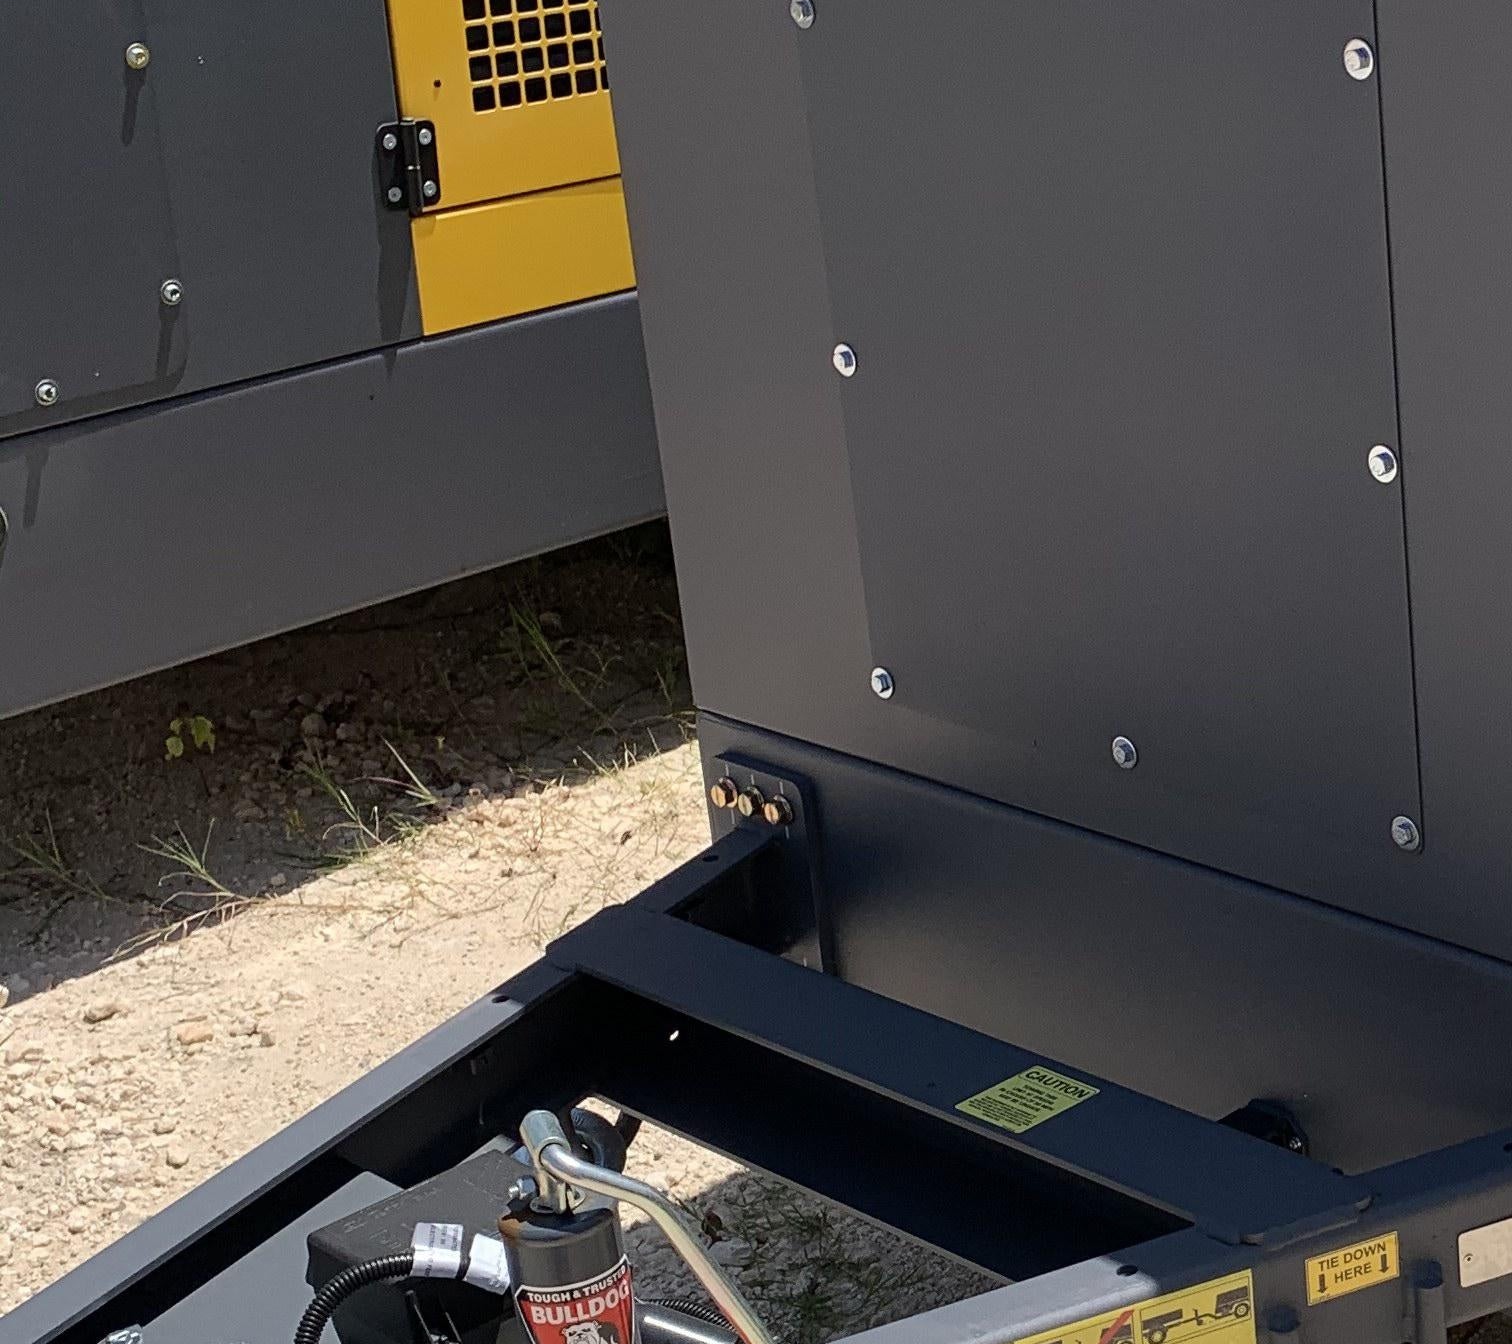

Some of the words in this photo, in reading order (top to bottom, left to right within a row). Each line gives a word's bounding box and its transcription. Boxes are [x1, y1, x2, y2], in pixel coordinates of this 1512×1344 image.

[1025, 1071, 1090, 1098] CAUTION
[1318, 1257, 1339, 1272] TIE
[1343, 1242, 1387, 1266] DOWN
[527, 1292, 571, 1303] TOUGH
[572, 1291, 581, 1299] &
[582, 1265, 626, 1296] TRUSTED
[1334, 1262, 1372, 1284] HERE
[531, 1279, 629, 1324] BULLDOG
